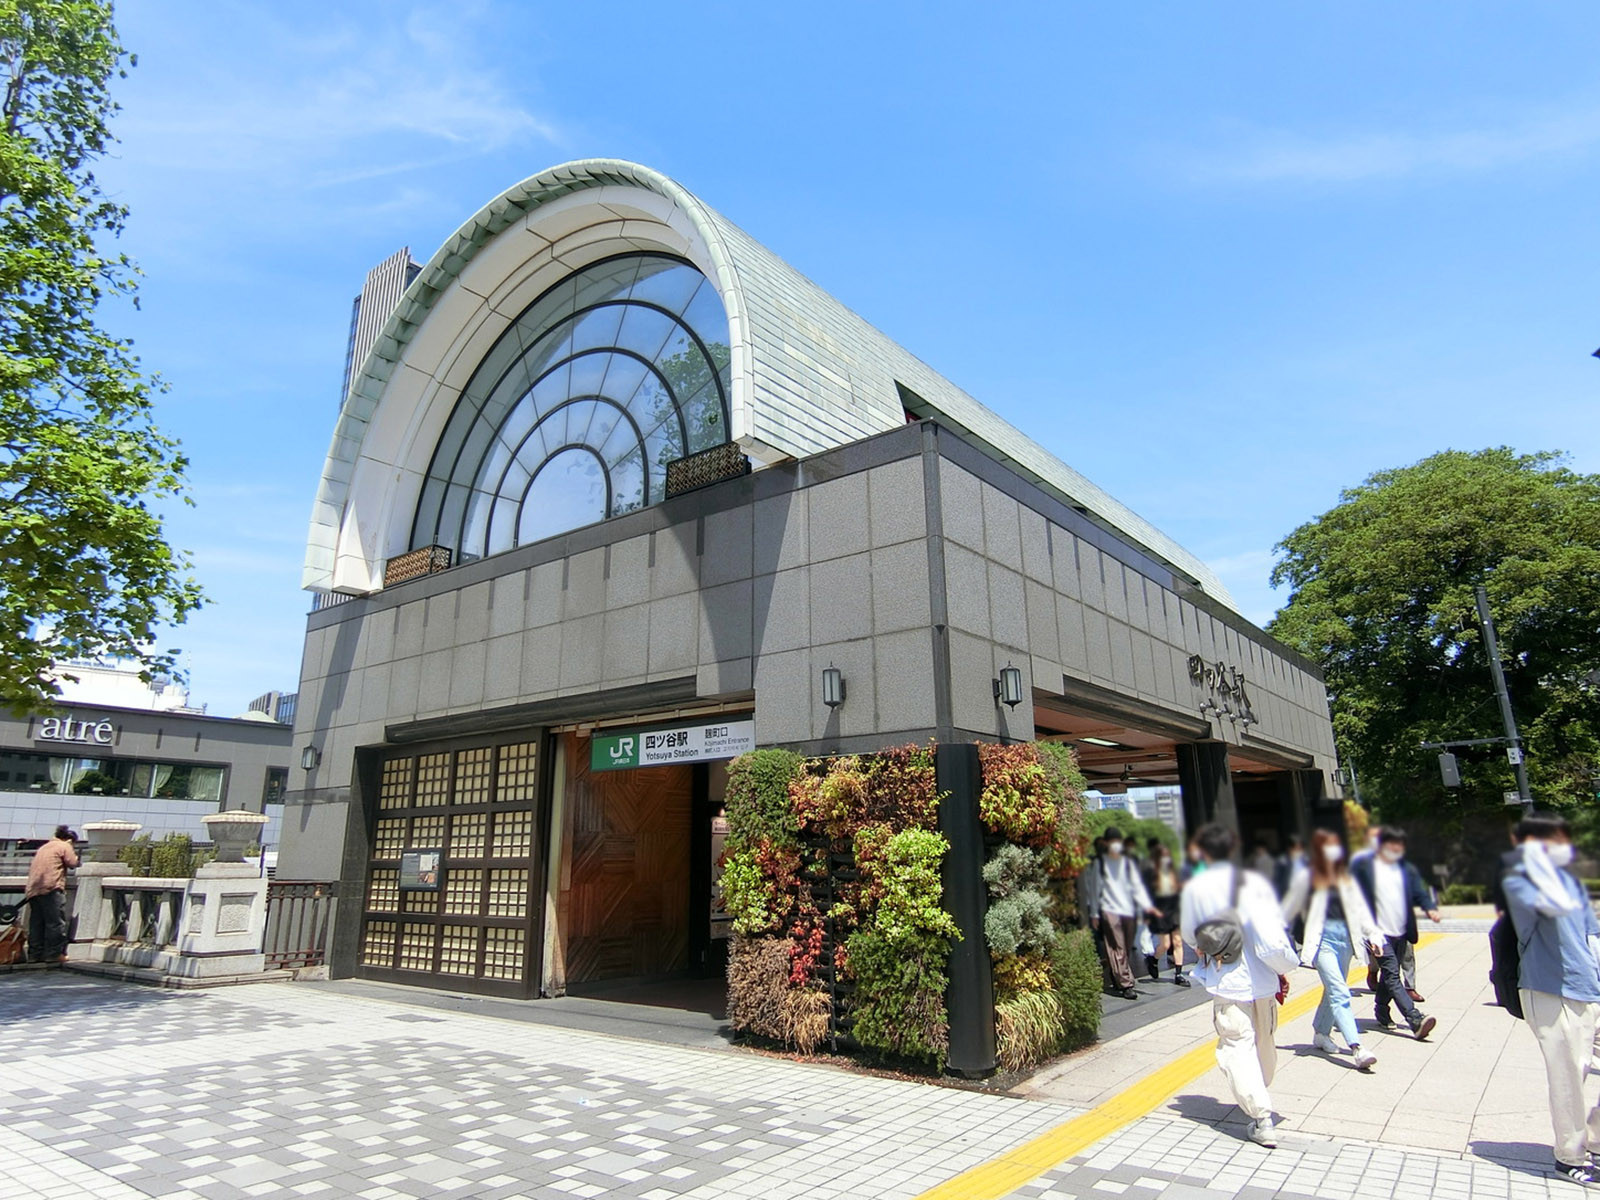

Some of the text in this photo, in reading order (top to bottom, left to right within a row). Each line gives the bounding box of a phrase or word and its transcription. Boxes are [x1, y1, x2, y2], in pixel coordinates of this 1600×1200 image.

[40, 713, 113, 743] atré
[609, 737, 634, 758] JR
[645, 731, 688, 749] 四ツ谷駅
[727, 736, 749, 744] Entrance
[645, 750, 673, 761] Yotsuya
[673, 747, 699, 758] Station
